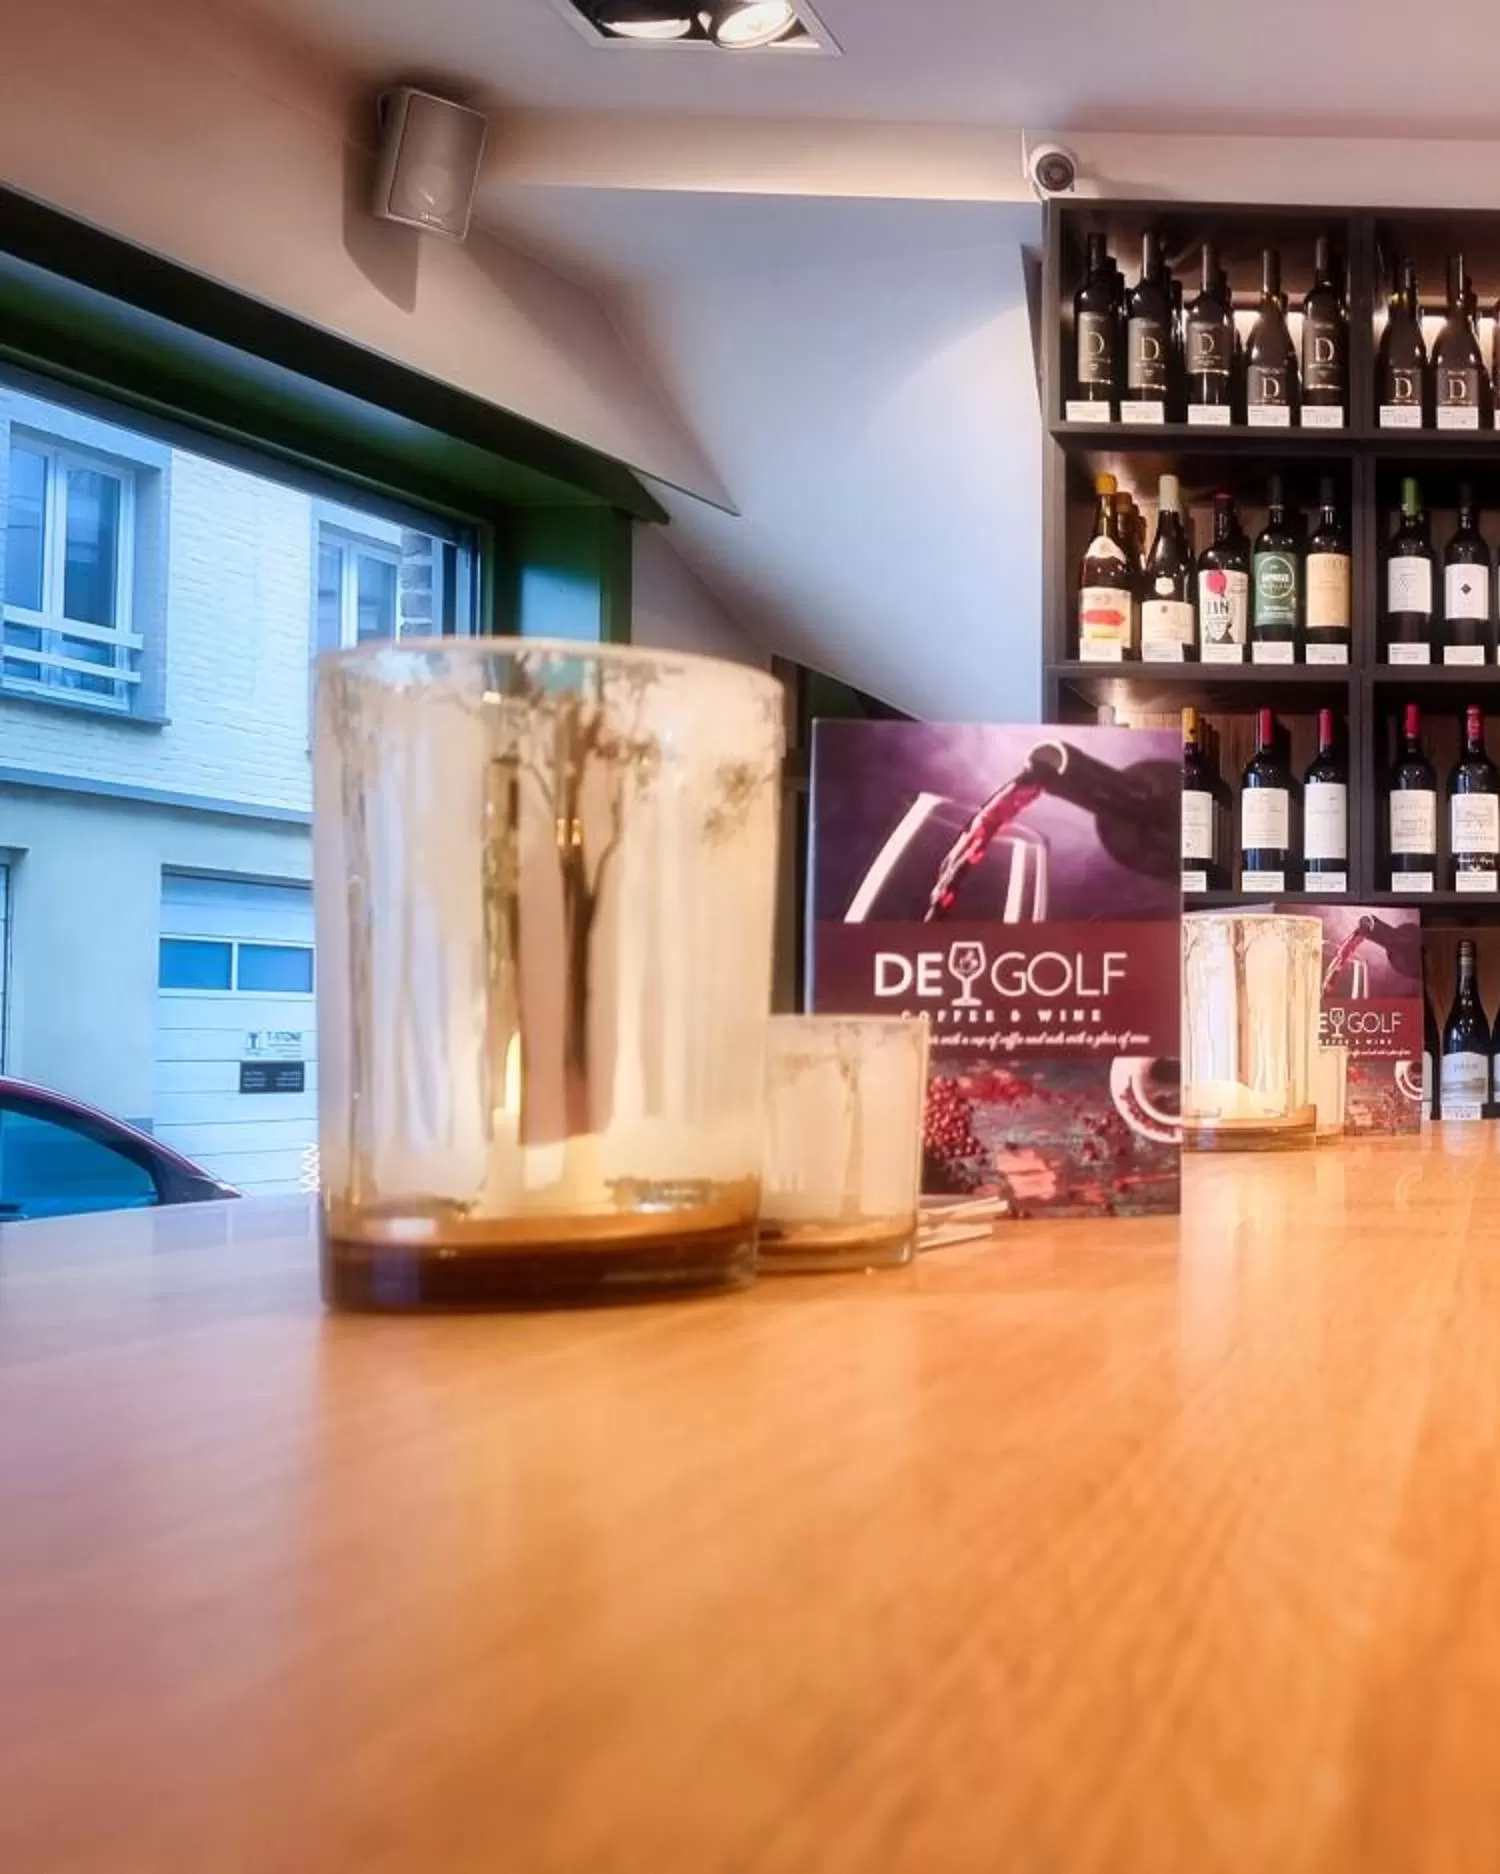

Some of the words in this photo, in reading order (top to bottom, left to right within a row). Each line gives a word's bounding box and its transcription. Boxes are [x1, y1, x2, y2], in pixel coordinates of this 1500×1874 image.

[1087, 331, 1105, 354] D
[1140, 336, 1160, 361] D
[1199, 332, 1215, 354] D
[1316, 336, 1335, 362] D
[1262, 376, 1280, 398] D
[1394, 376, 1413, 399] D
[1447, 378, 1467, 399] D
[873, 951, 945, 997] DE
[991, 951, 1129, 998] GOLF
[1037, 1009, 1101, 1022] WINE
[1347, 1011, 1402, 1033] GOLF
